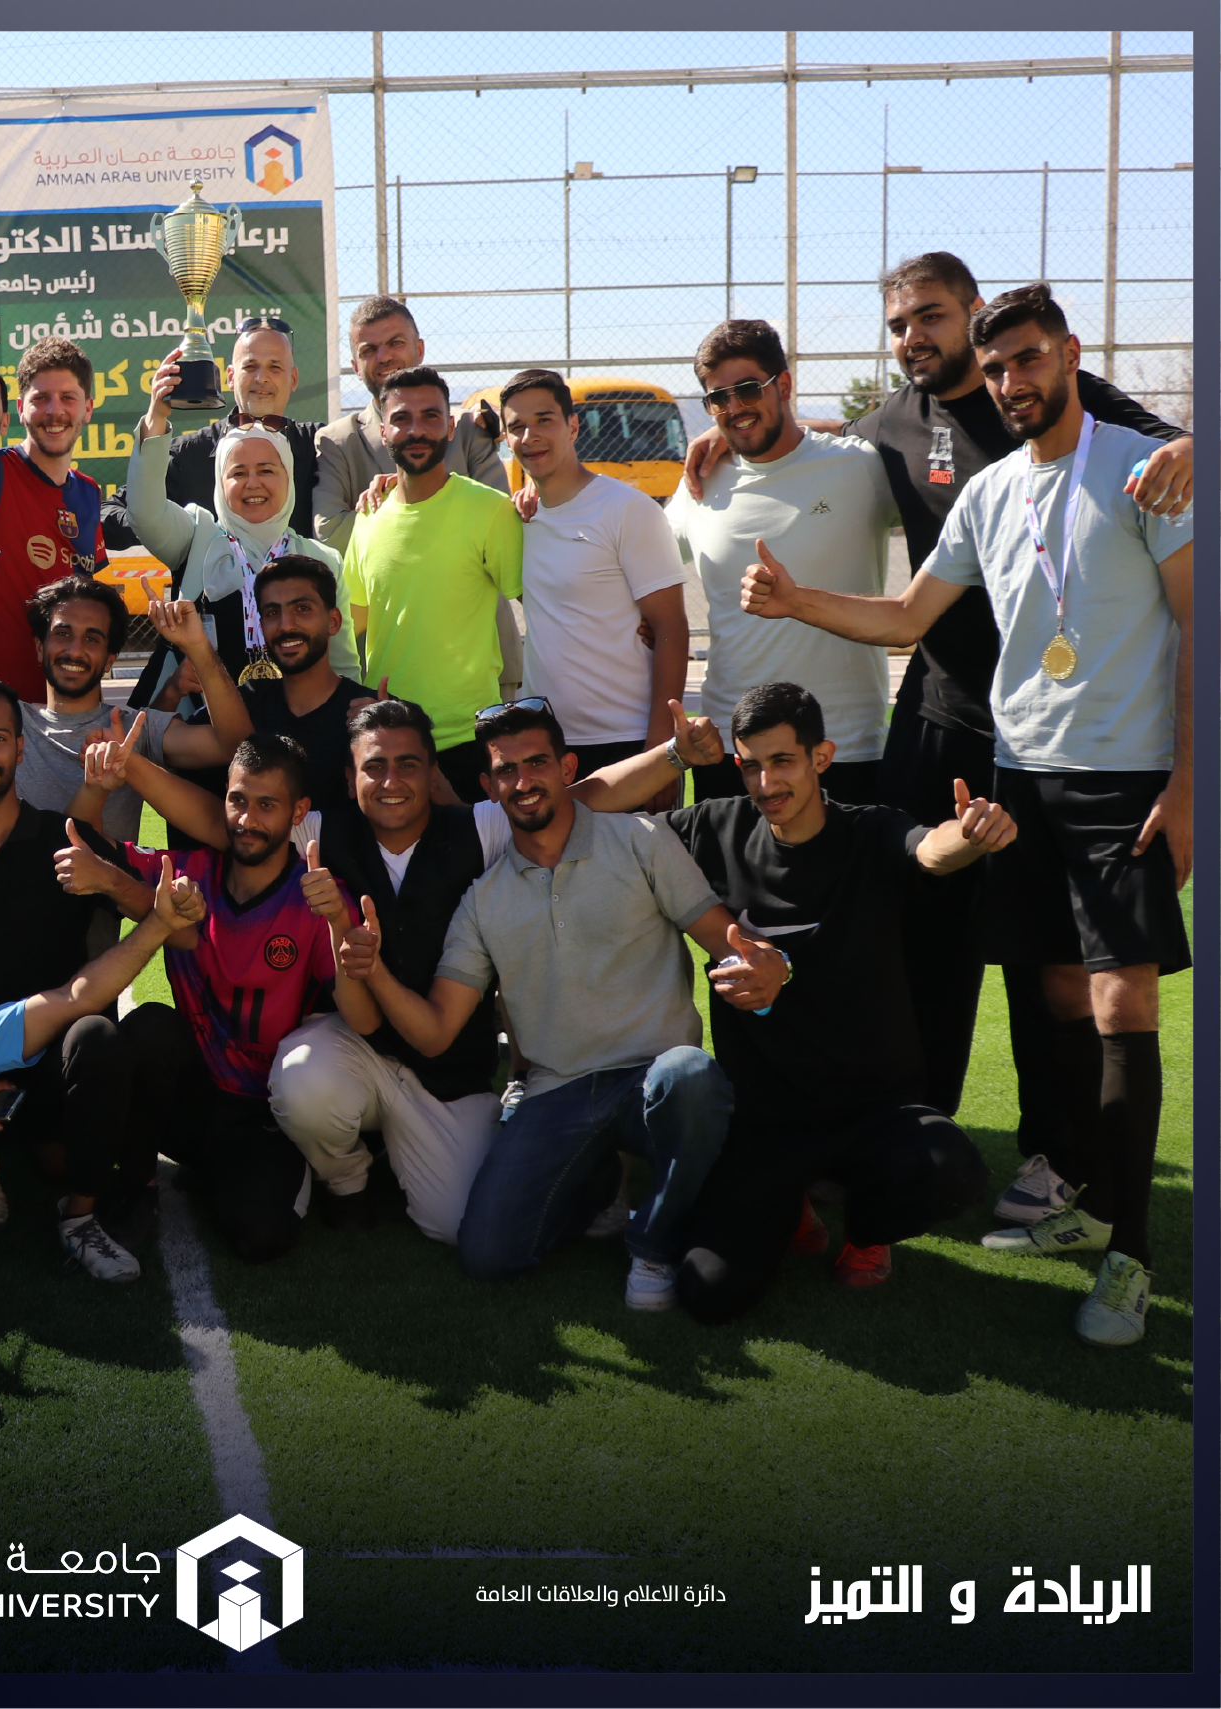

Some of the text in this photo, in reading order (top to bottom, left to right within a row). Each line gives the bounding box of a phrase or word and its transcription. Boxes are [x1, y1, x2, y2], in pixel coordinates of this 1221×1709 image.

[34, 144, 236, 169] جامعة عمان العربية
[36, 167, 236, 187] AMMAN ARAB UNIVERSITY
[46, 270, 95, 295] رئيس
[9, 309, 103, 350] شؤون
